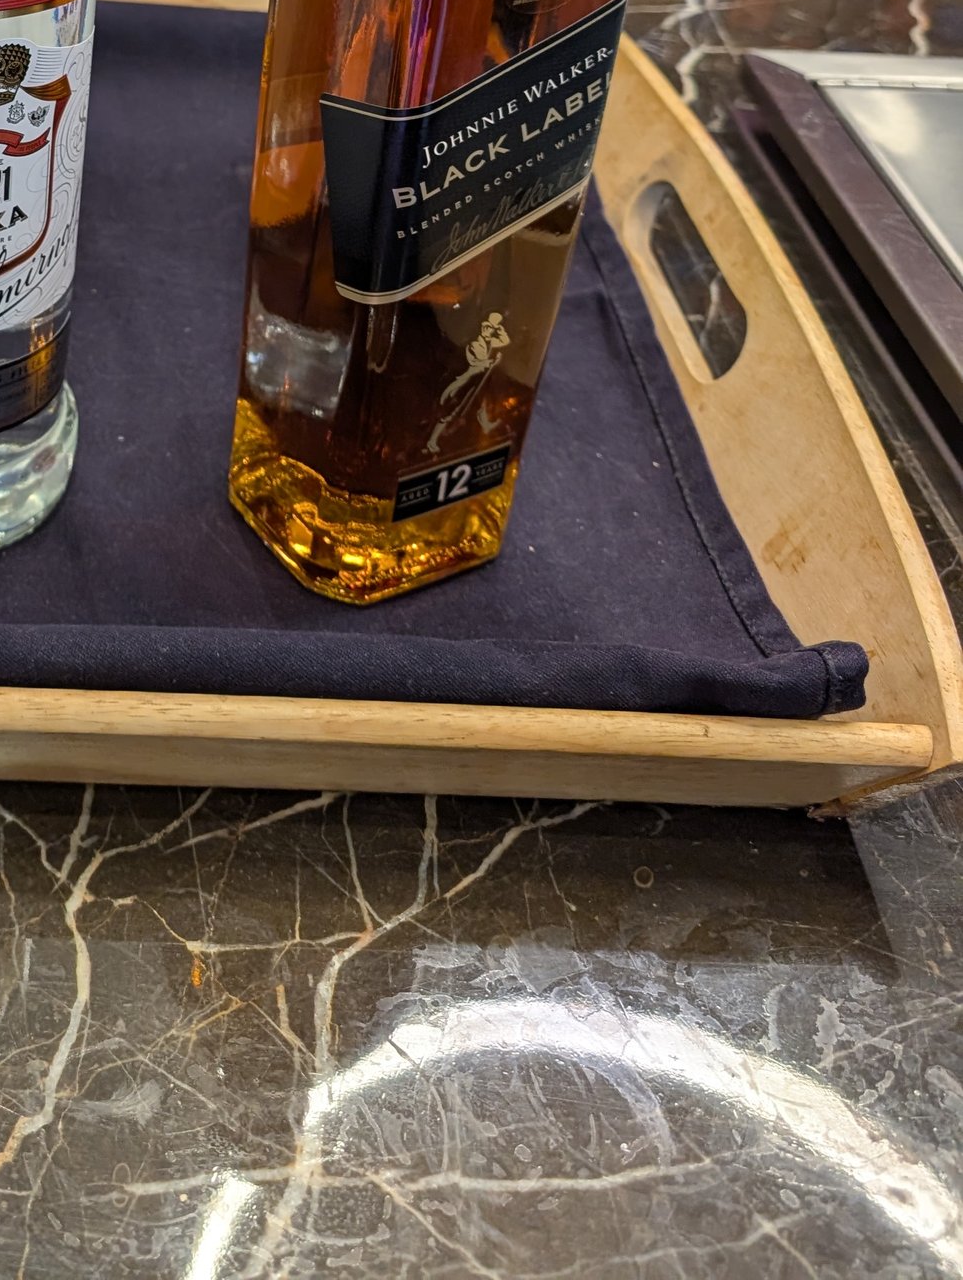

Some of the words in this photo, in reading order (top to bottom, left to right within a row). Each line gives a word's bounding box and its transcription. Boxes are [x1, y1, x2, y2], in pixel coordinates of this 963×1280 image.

[422, 99, 519, 168] JOHNNIE
[392, 134, 510, 208] BLACK
[397, 195, 473, 239] BLENDED
[484, 152, 545, 192] SCOTCH
[437, 464, 473, 502] 12
